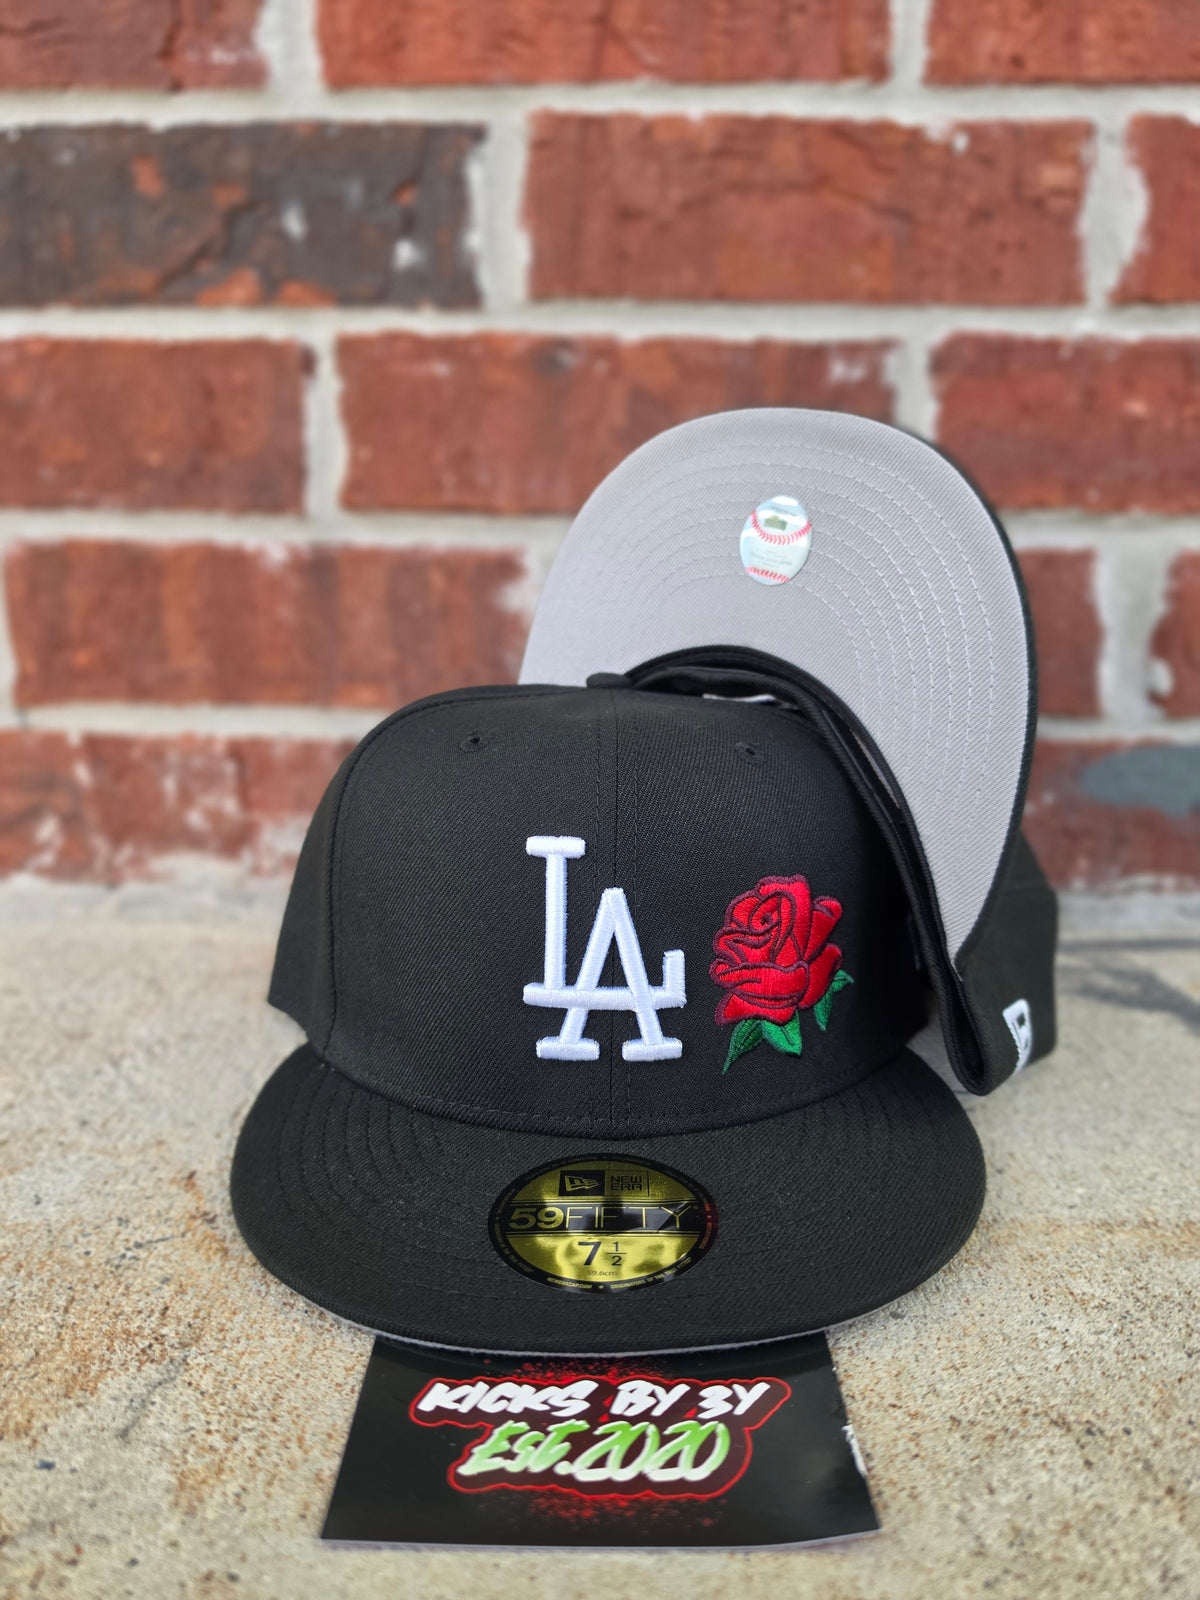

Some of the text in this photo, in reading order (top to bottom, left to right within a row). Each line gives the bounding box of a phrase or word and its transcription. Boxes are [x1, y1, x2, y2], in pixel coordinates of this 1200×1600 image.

[523, 836, 687, 1061] LA
[610, 1175, 642, 1183] NEW
[610, 1183, 643, 1191] ERA
[508, 1206, 692, 1229] 59FIFTY
[577, 1241, 602, 1266] 7
[417, 1379, 600, 1417] KICKS
[609, 1379, 691, 1417] BY
